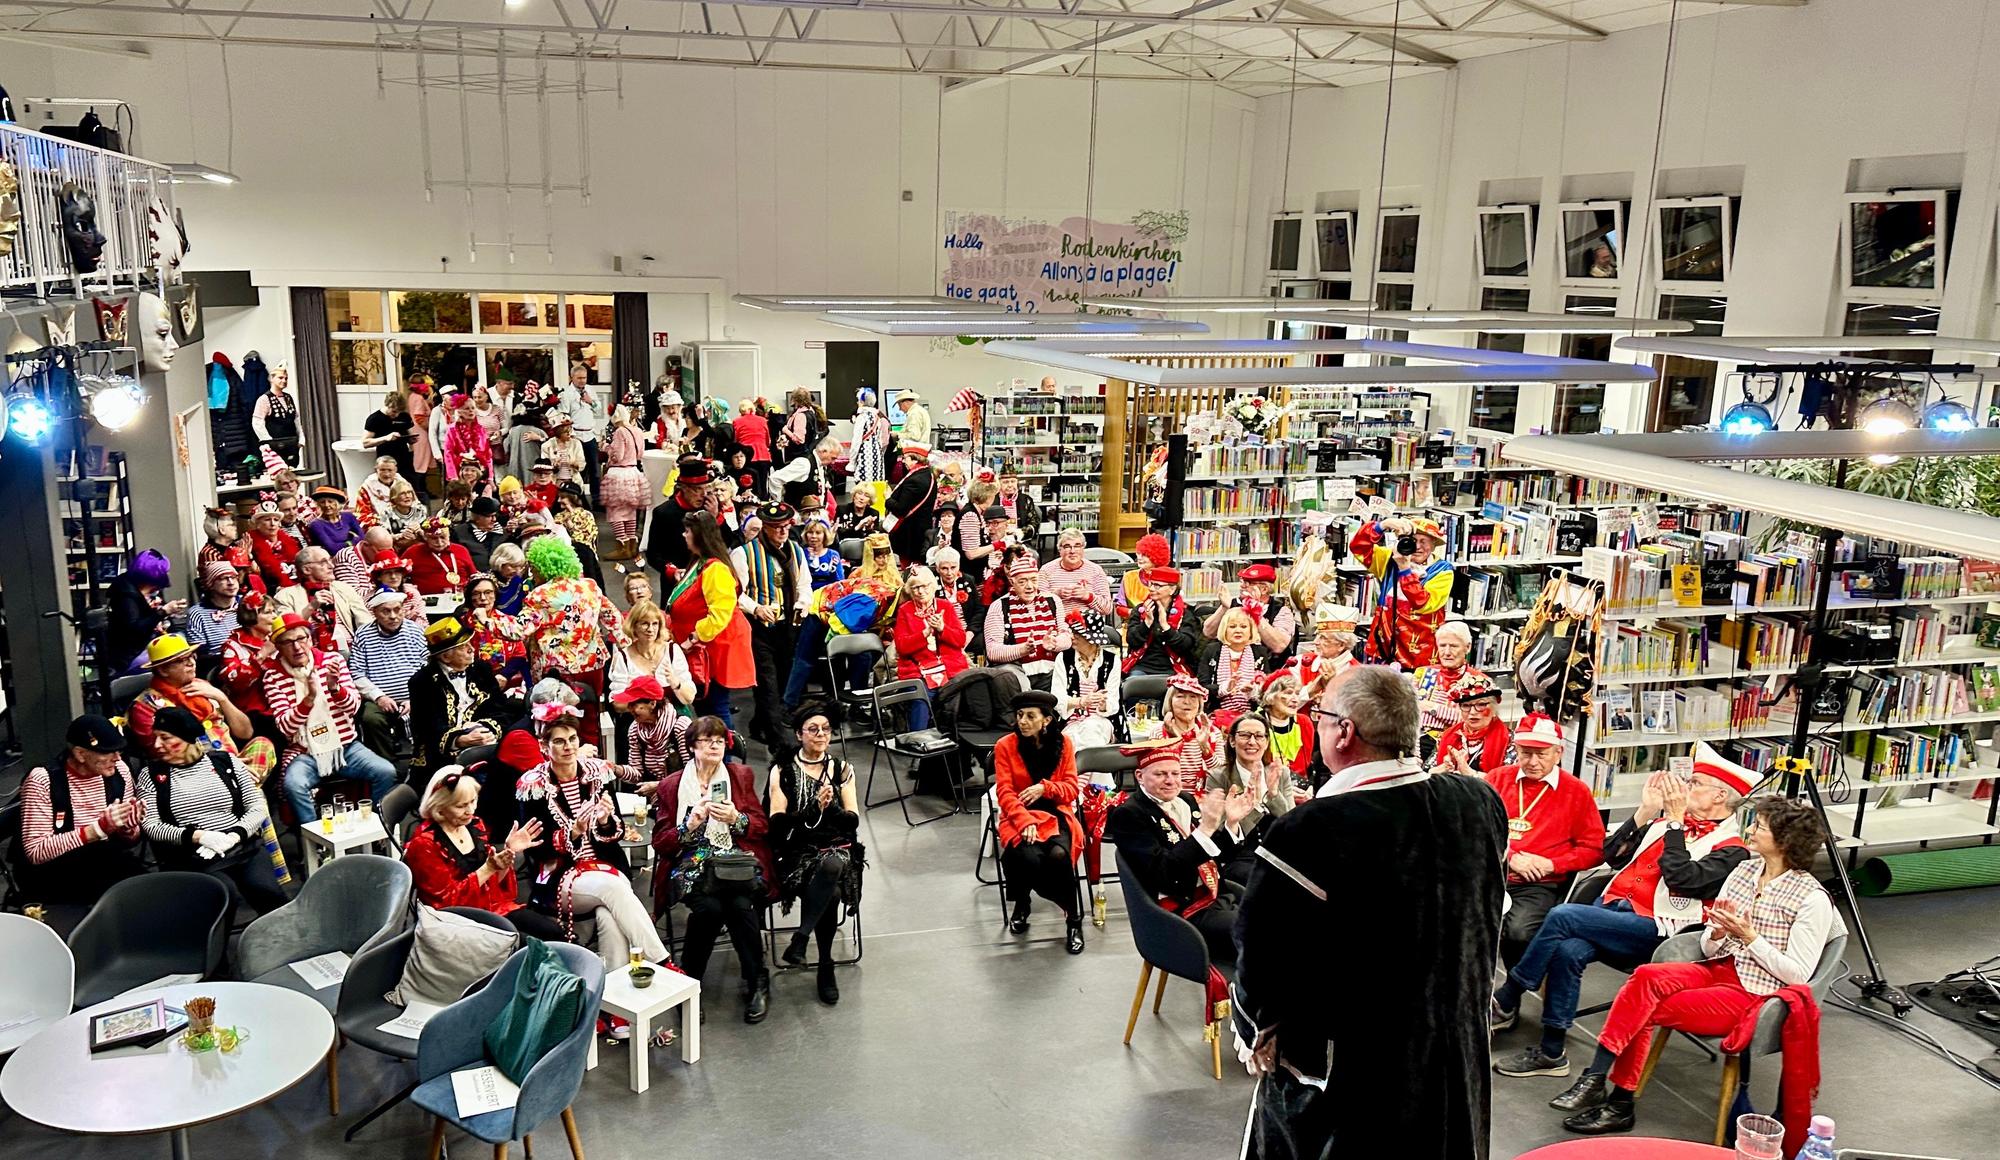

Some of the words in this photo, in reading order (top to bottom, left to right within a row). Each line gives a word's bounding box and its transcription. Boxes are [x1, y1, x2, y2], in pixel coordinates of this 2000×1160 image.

[944, 233, 984, 250] Hallo
[1060, 233, 1183, 262] Rodenkirchen
[1040, 261, 1083, 283] Allons
[1085, 263, 1096, 281] à
[1100, 263, 1114, 283] la
[1116, 261, 1176, 288] plage!
[946, 283, 973, 299] Hoe
[479, 1068, 500, 1107] RESERVIERT
